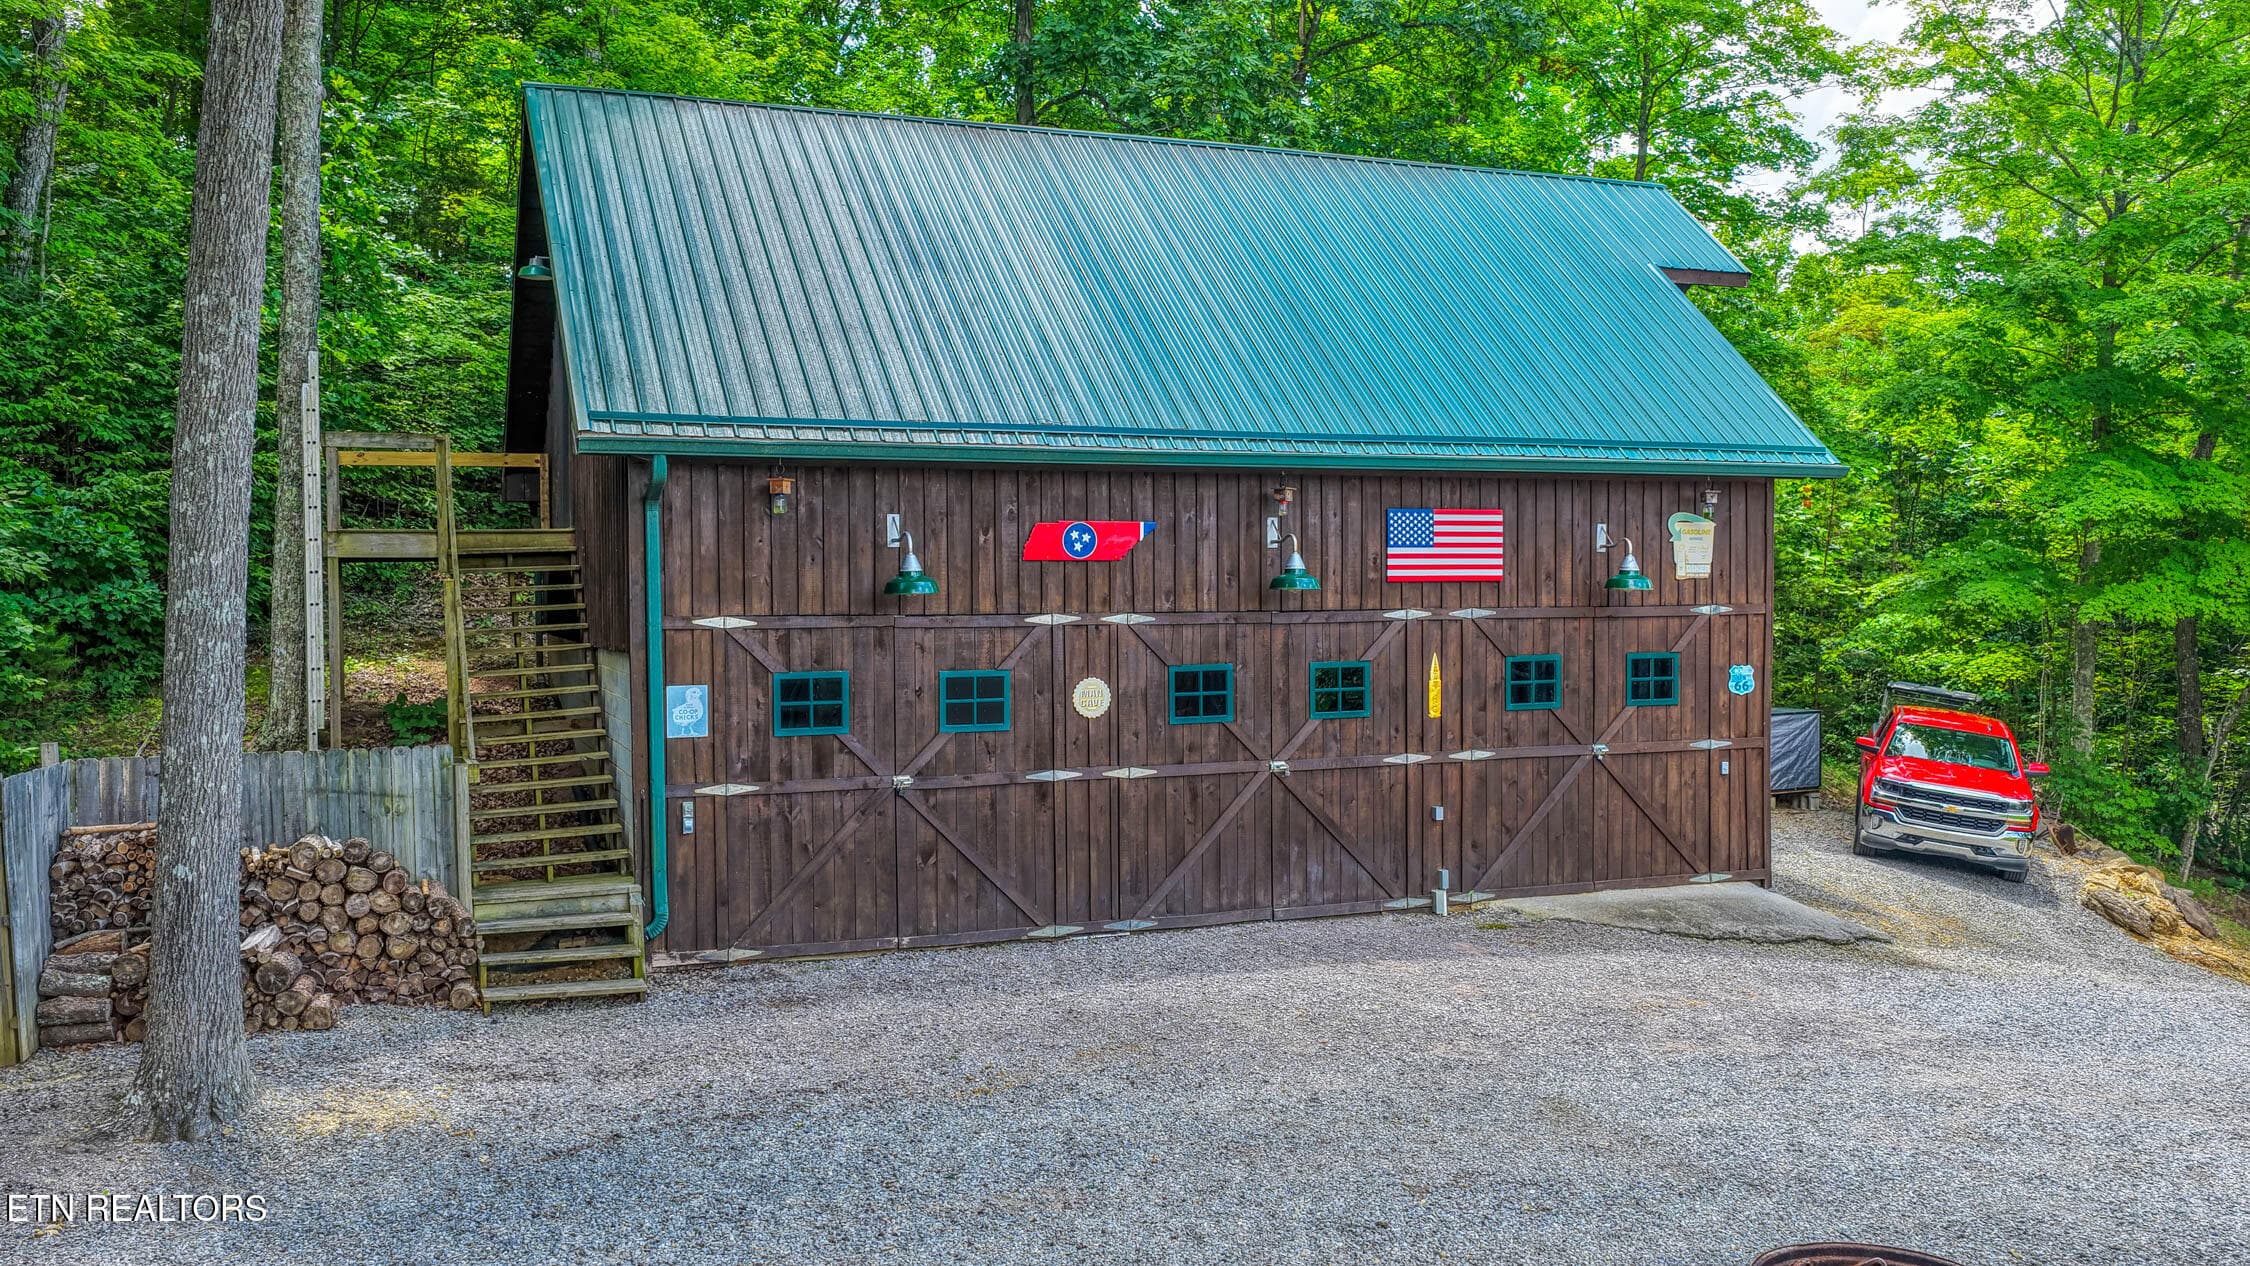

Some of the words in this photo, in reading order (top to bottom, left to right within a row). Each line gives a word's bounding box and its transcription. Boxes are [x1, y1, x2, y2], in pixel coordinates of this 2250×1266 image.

[1734, 681, 1749, 691] 66
[1081, 689, 1103, 698] MAN
[1081, 699, 1104, 708] CAVE
